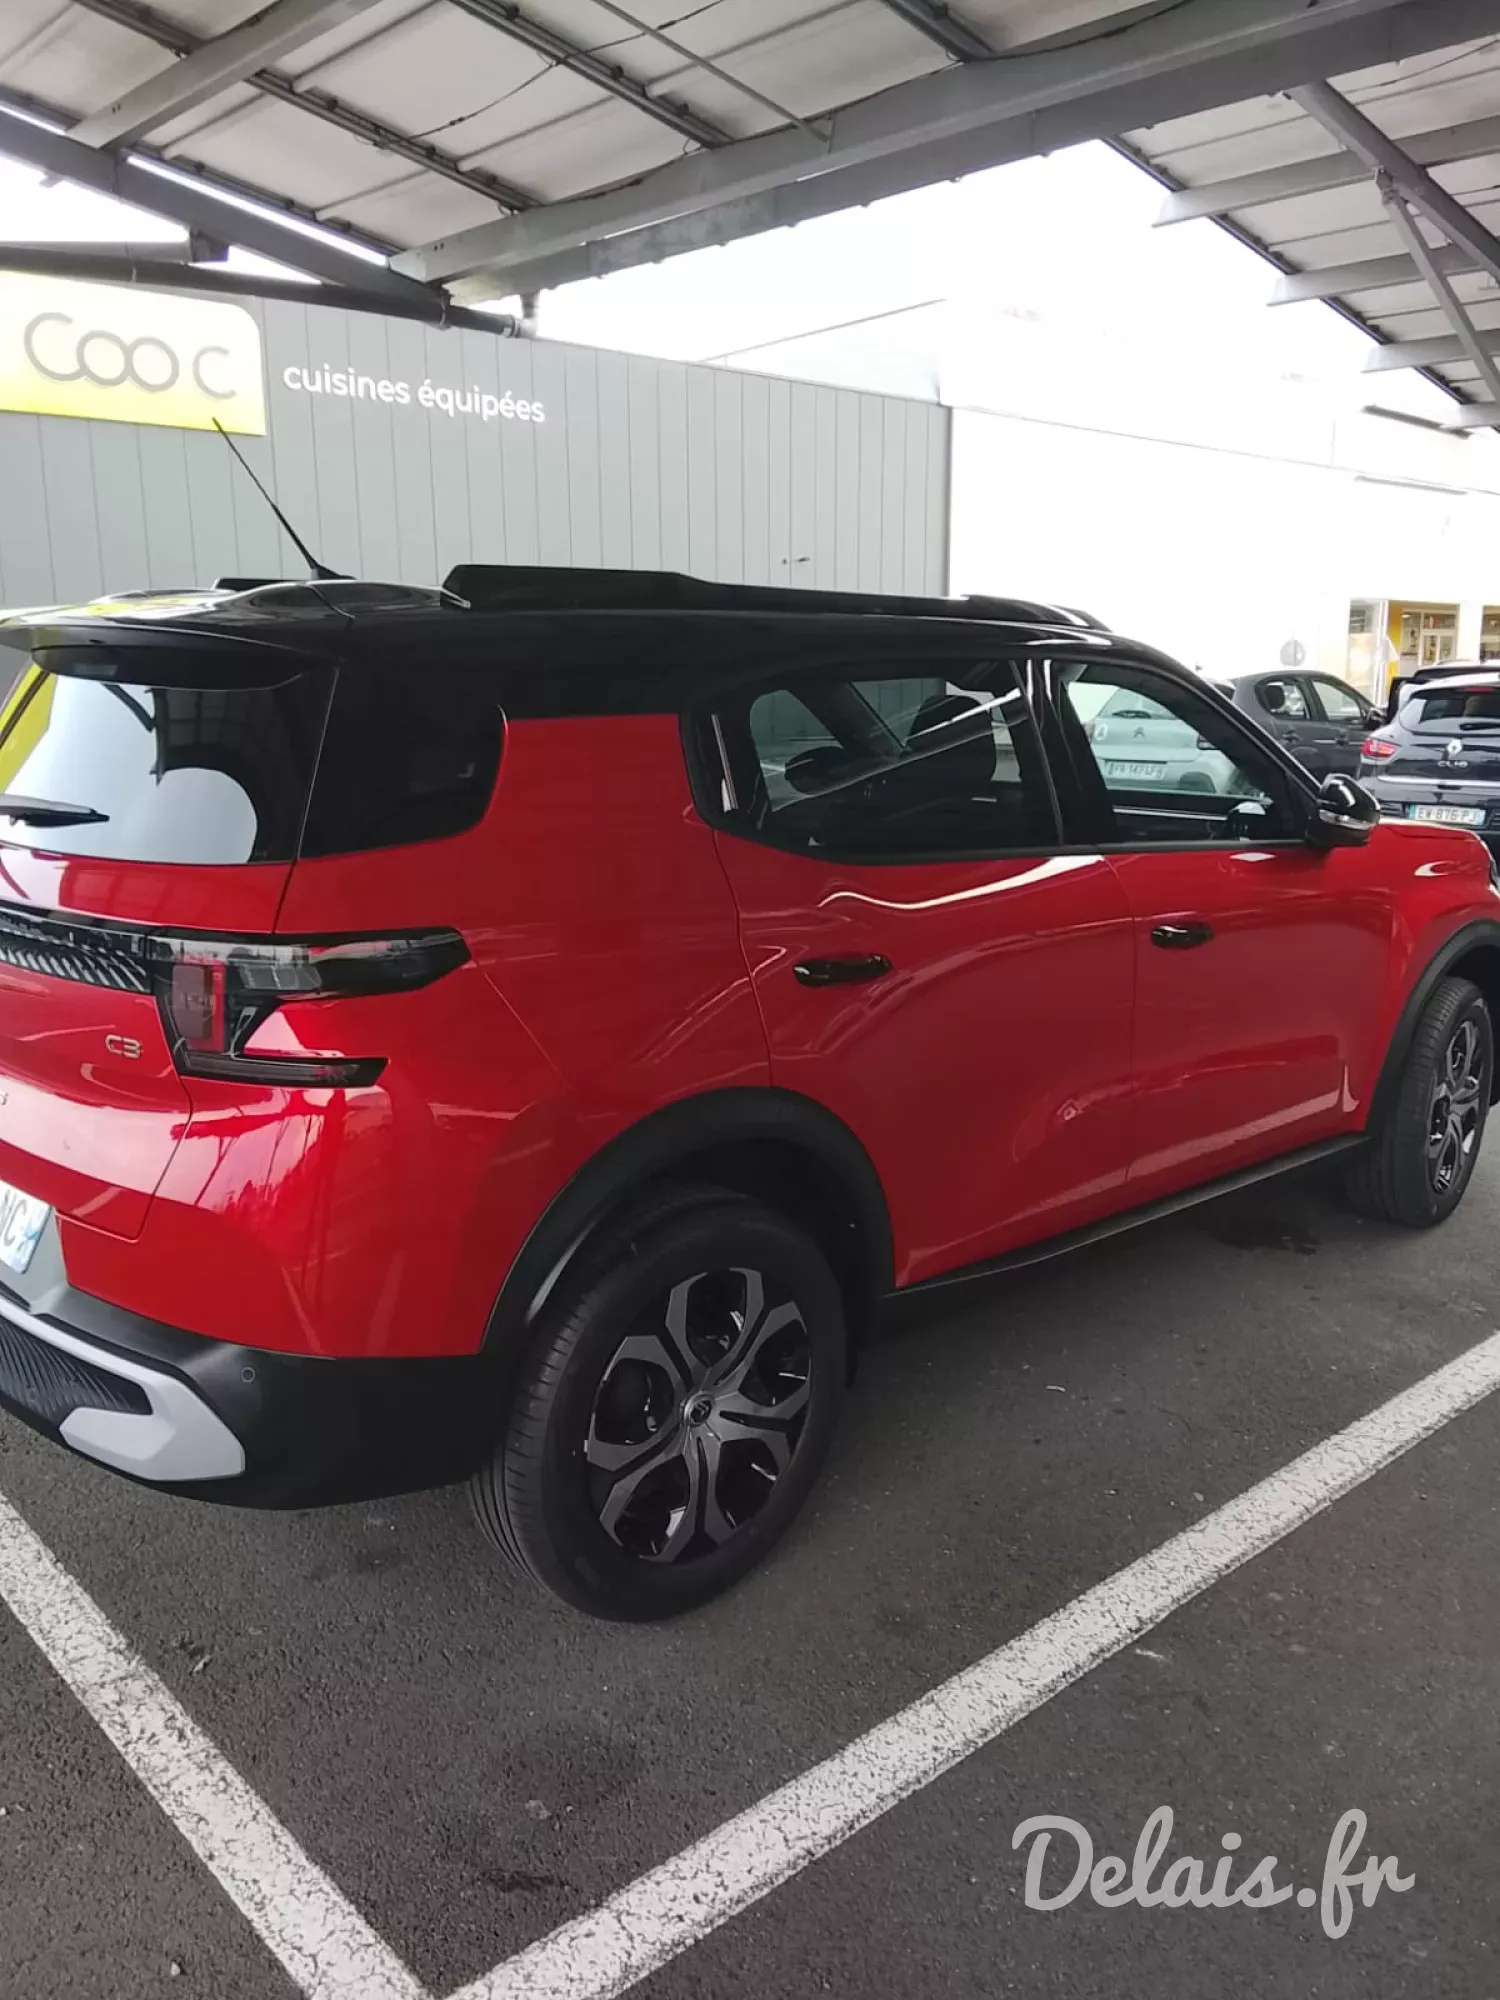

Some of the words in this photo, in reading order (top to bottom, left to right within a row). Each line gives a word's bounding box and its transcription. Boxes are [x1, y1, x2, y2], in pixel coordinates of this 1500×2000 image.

[283, 363, 411, 404] cuisines
[417, 379, 546, 422] équipées
[105, 1034, 141, 1058] C3
